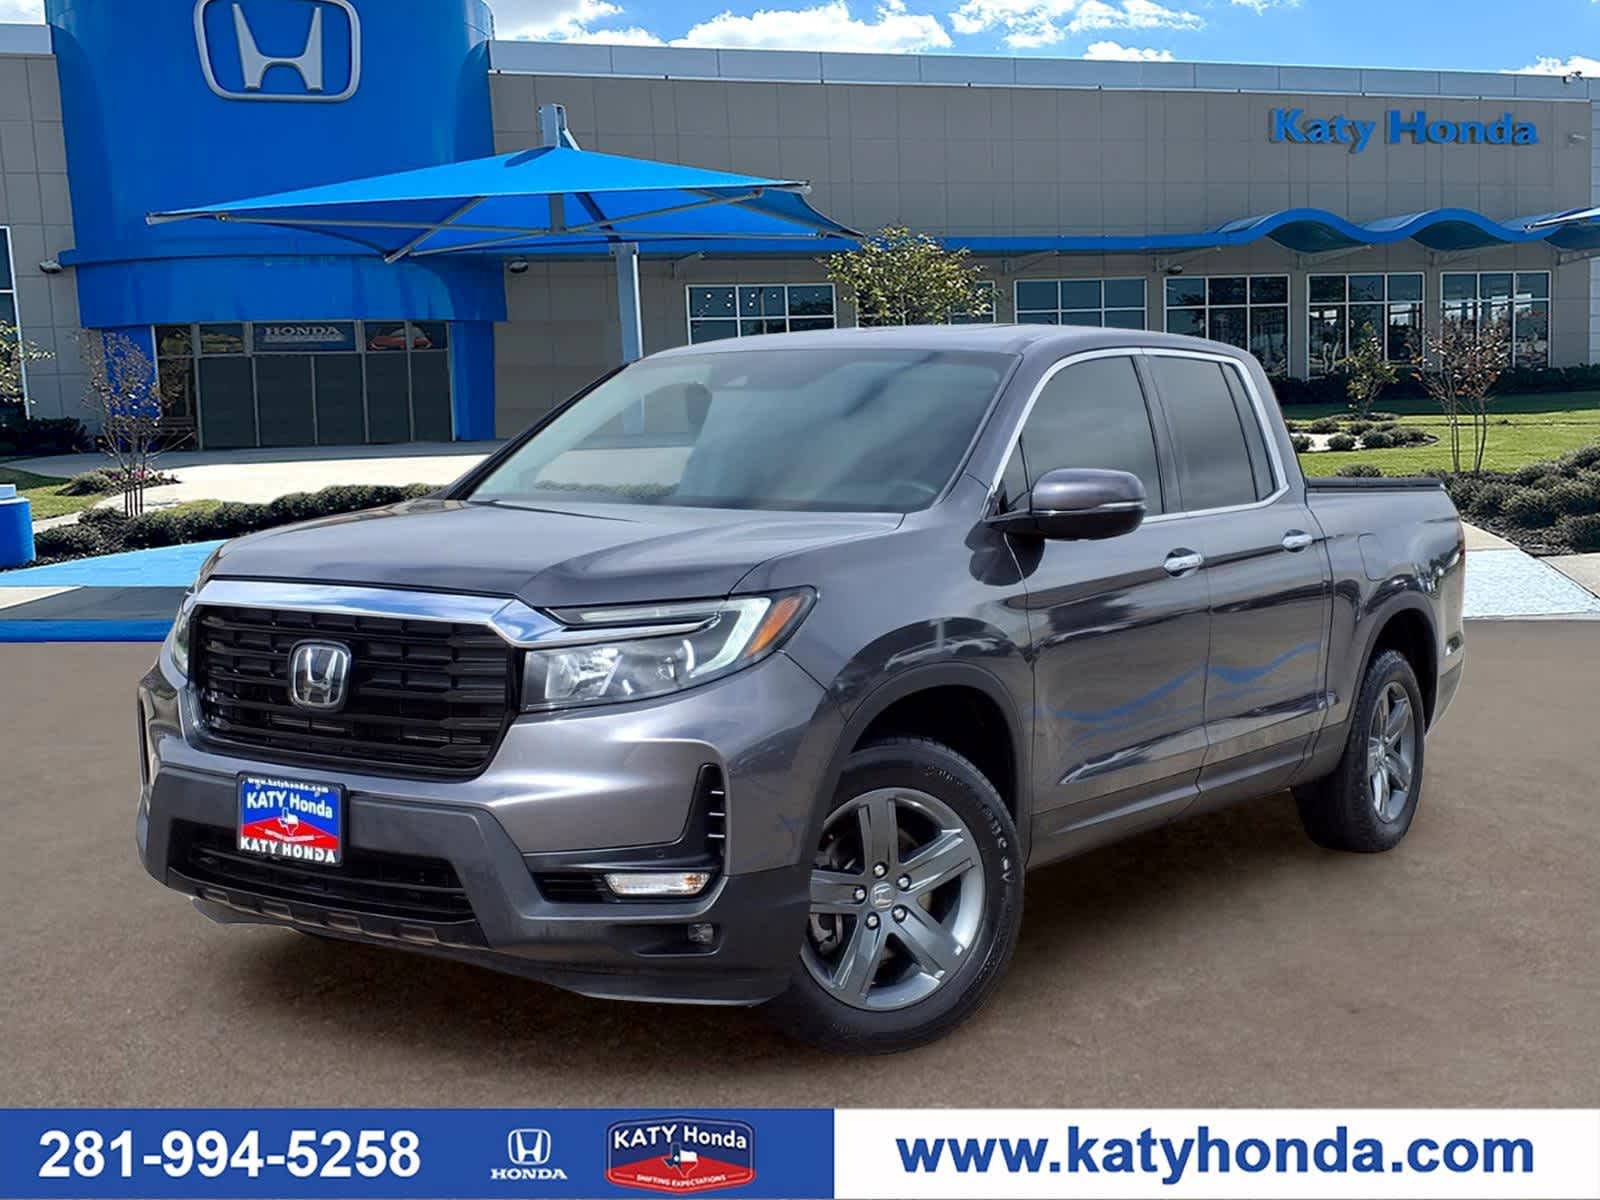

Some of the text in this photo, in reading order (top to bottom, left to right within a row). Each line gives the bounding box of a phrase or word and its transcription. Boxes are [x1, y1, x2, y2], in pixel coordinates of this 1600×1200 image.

[1271, 107, 1541, 154] Katy Honda
[264, 326, 345, 336] HONDA
[246, 791, 333, 819] KATY Honda
[240, 836, 336, 863] KATY HONDA
